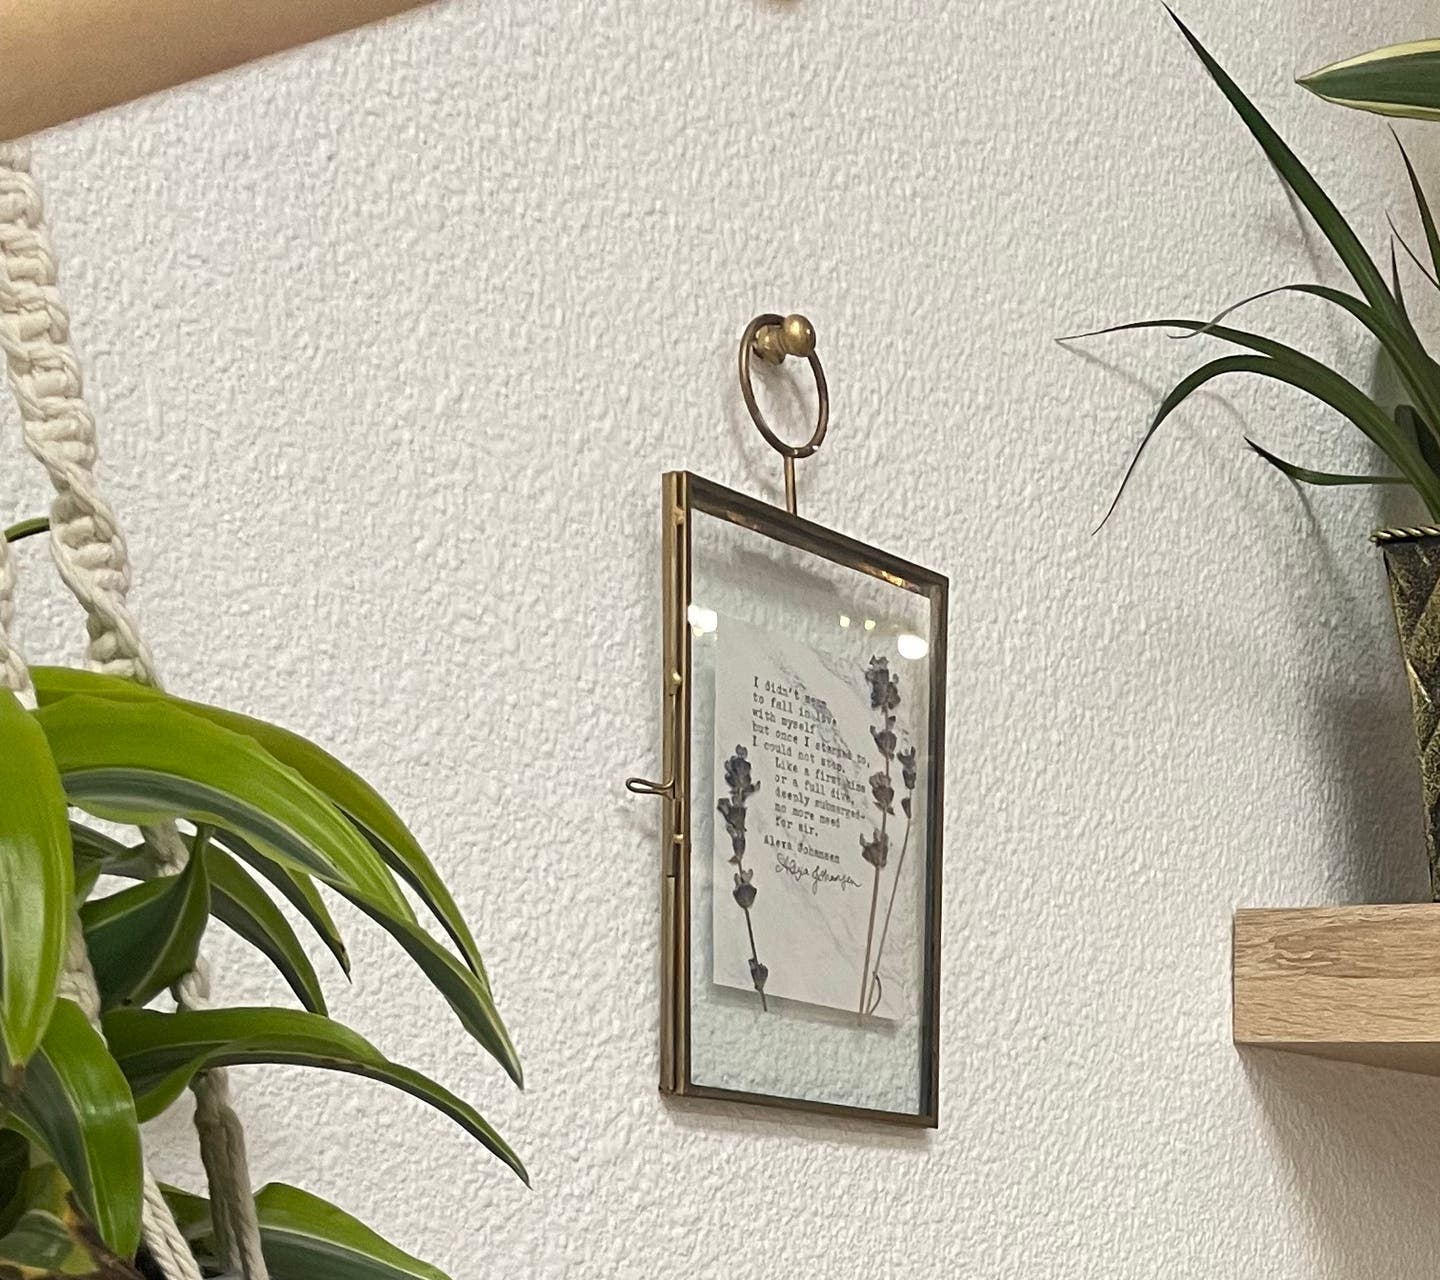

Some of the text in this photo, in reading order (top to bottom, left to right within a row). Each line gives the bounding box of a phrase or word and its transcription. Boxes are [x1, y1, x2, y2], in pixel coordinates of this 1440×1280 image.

[765, 680, 800, 700] didn't
[753, 692, 764, 704] to
[771, 697, 793, 714] fall
[752, 708, 816, 735] with myself
[752, 720, 769, 736] but
[775, 730, 798, 745] once
[763, 742, 792, 757] could
[798, 751, 815, 764] not
[775, 757, 798, 773] Like
[775, 774, 787, 785] or
[804, 780, 825, 796] full
[775, 816, 793, 829] for
[792, 807, 815, 821] more
